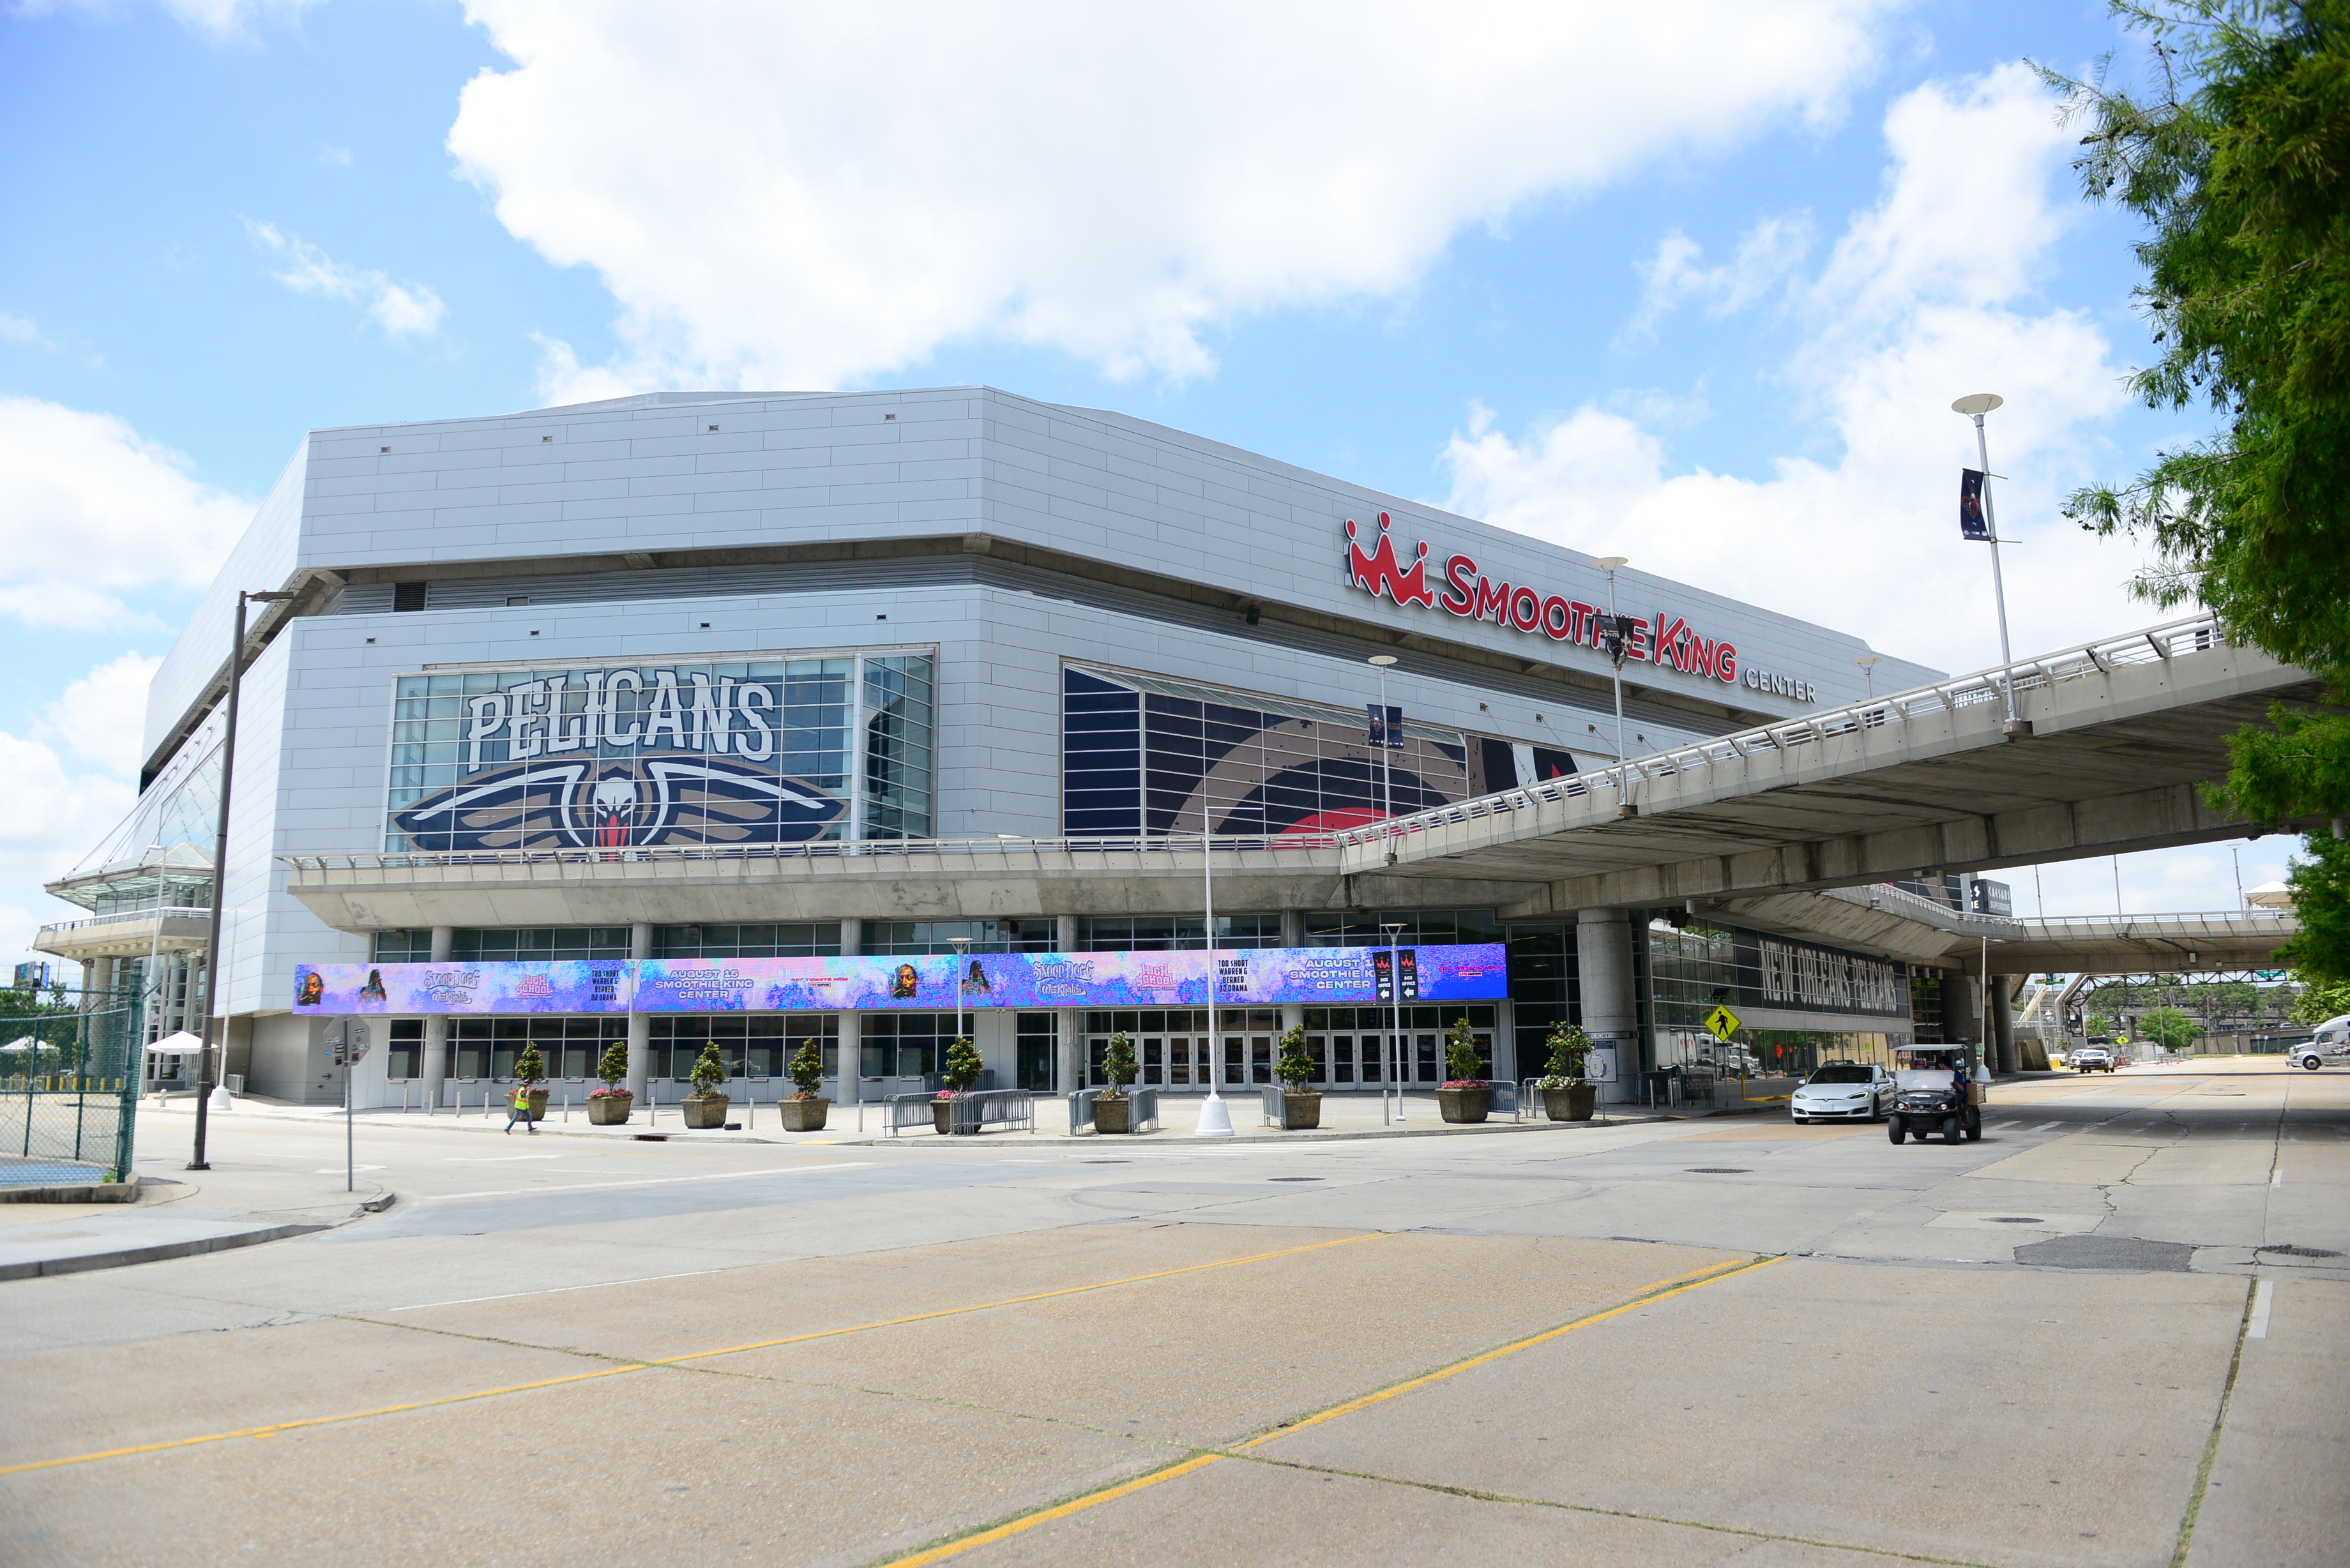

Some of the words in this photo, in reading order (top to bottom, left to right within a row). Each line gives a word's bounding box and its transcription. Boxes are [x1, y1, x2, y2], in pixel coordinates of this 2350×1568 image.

[1439, 553, 1650, 661] SMOOTE
[1744, 667, 1816, 704] CENTER
[466, 668, 775, 774] PELICANS
[1988, 886, 2010, 900] CAESARS
[1990, 900, 2011, 912] SUPERDOME
[1306, 959, 1360, 968] AUGUST
[670, 969, 720, 979] AUGUST
[724, 969, 739, 978] 15
[1033, 961, 1065, 979] SNOOP
[1065, 960, 1094, 980] DOGG
[1141, 963, 1170, 977] HIGH
[1289, 969, 1360, 979] SMOOTHIE
[1759, 940, 1794, 1002] NEW
[1798, 947, 1851, 1007] ORLEANS
[1851, 958, 1897, 1012] PELICANS
[424, 970, 453, 988] SNOOP
[453, 970, 480, 988] DOGG
[522, 973, 550, 985] HIGH
[655, 980, 720, 988] SMOOTHIE
[723, 979, 754, 988] KING
[1135, 973, 1177, 986] SCHOOL
[1316, 980, 1371, 989] CENTER
[516, 983, 553, 995] SCHOOL
[678, 990, 729, 999] CENTER
